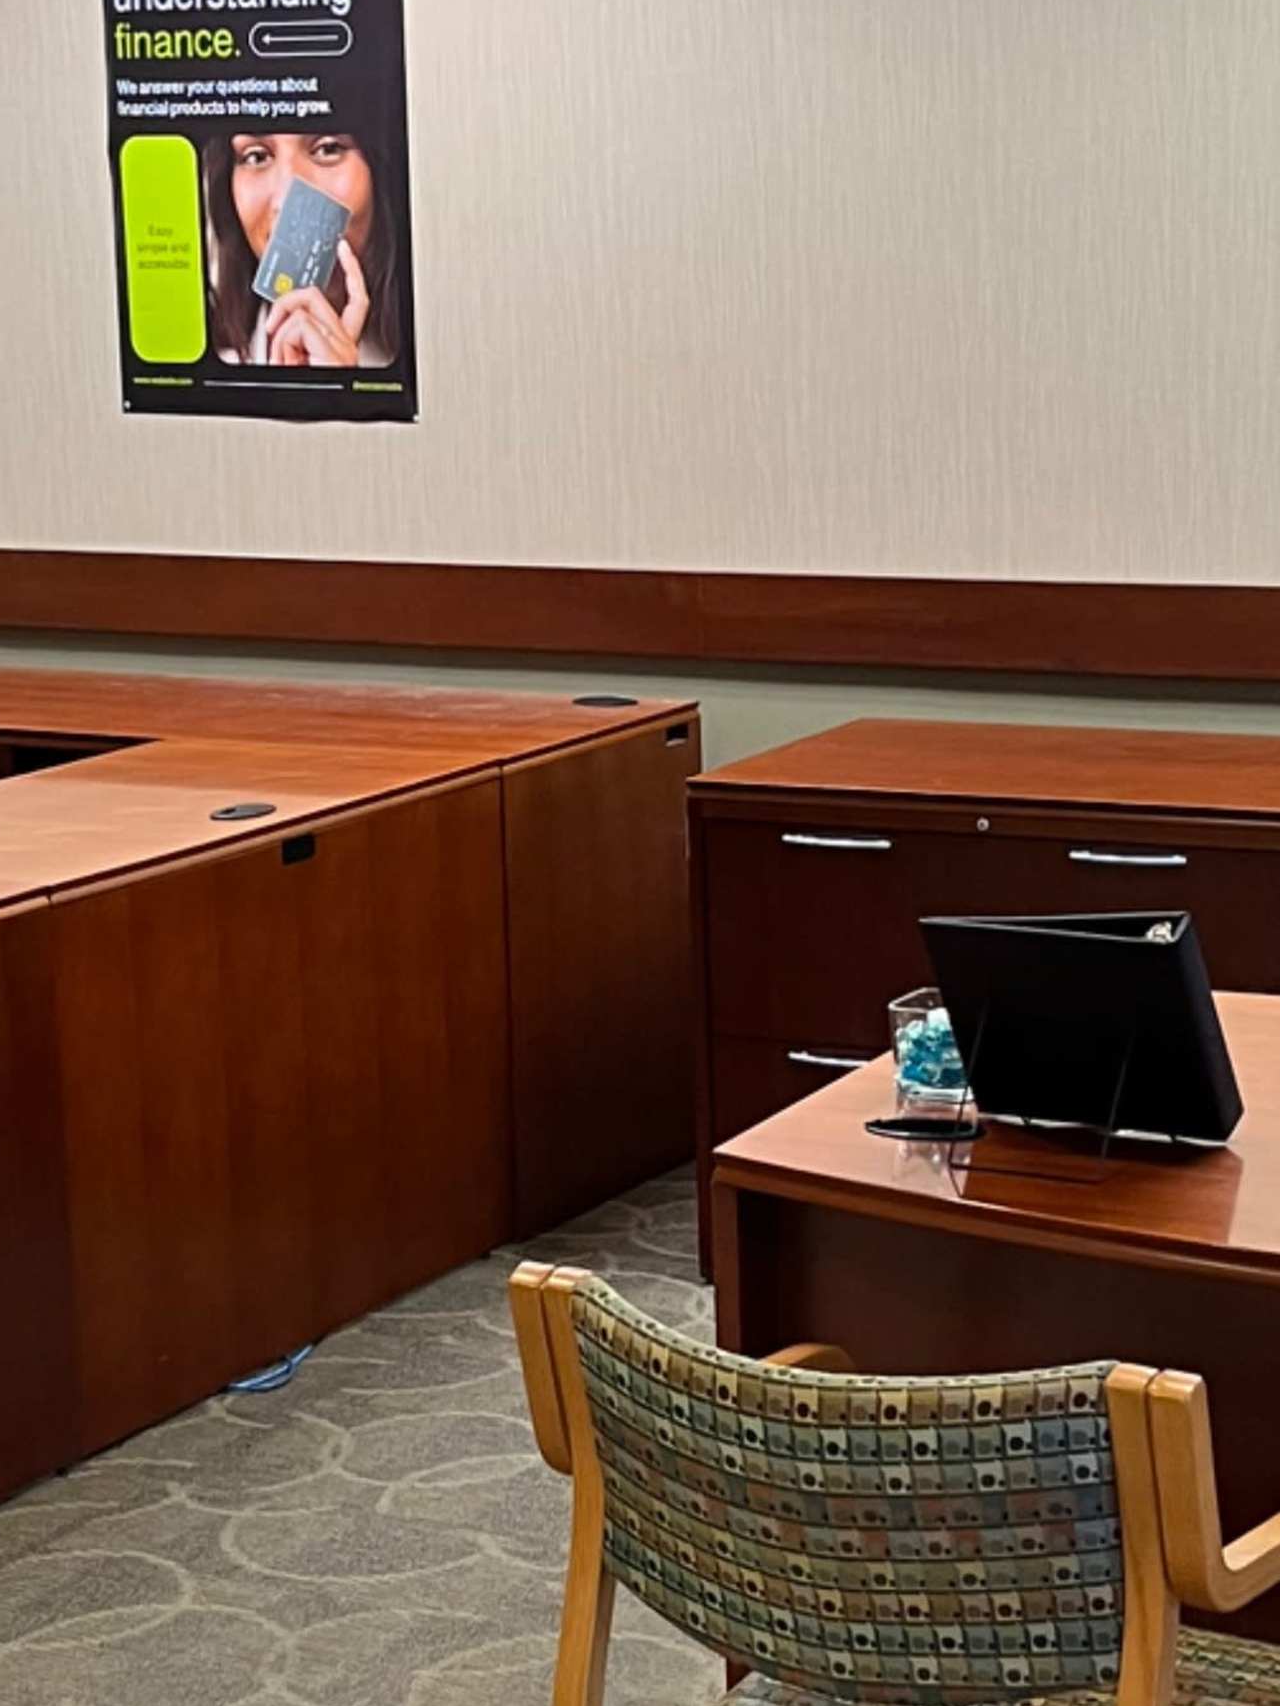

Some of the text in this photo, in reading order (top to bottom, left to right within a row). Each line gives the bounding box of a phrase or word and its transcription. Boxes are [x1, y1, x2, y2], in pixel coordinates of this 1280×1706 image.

[113, 22, 241, 61] finance.
[116, 76, 319, 97] We answer your questions about
[117, 99, 168, 116] financial
[169, 99, 225, 119] products
[226, 100, 239, 115] to
[240, 98, 270, 118] help
[271, 101, 295, 118] you
